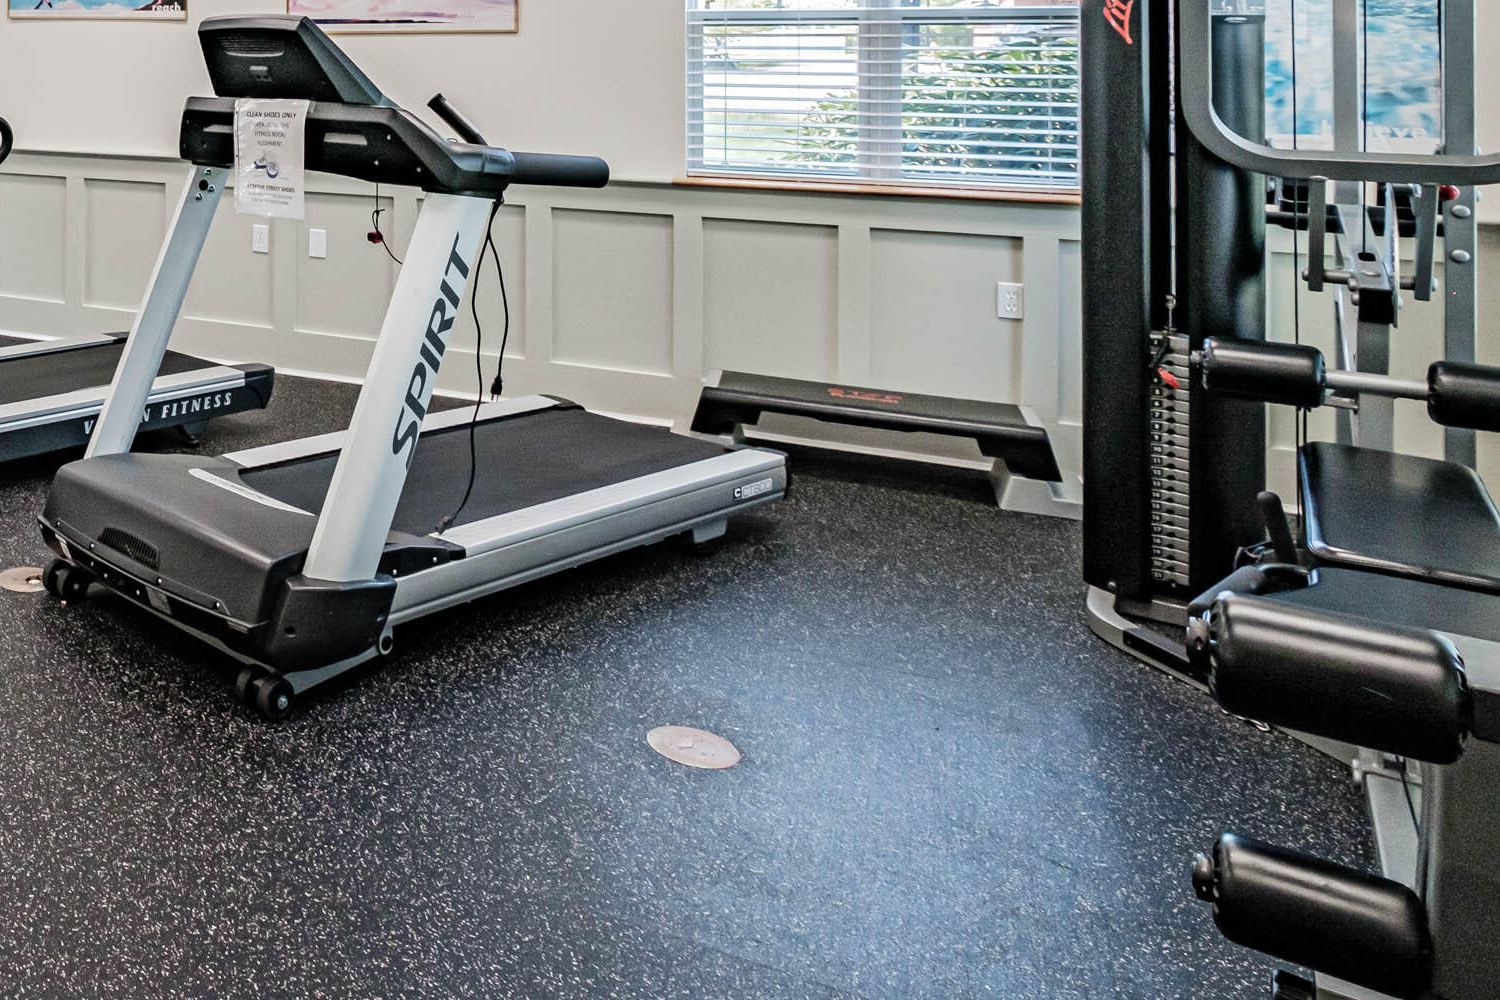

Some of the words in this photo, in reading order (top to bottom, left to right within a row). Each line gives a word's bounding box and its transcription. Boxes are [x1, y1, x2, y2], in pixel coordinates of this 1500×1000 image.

[151, 1, 181, 12] reach
[392, 231, 470, 473] SPIRIT
[161, 391, 233, 419] FITNESS
